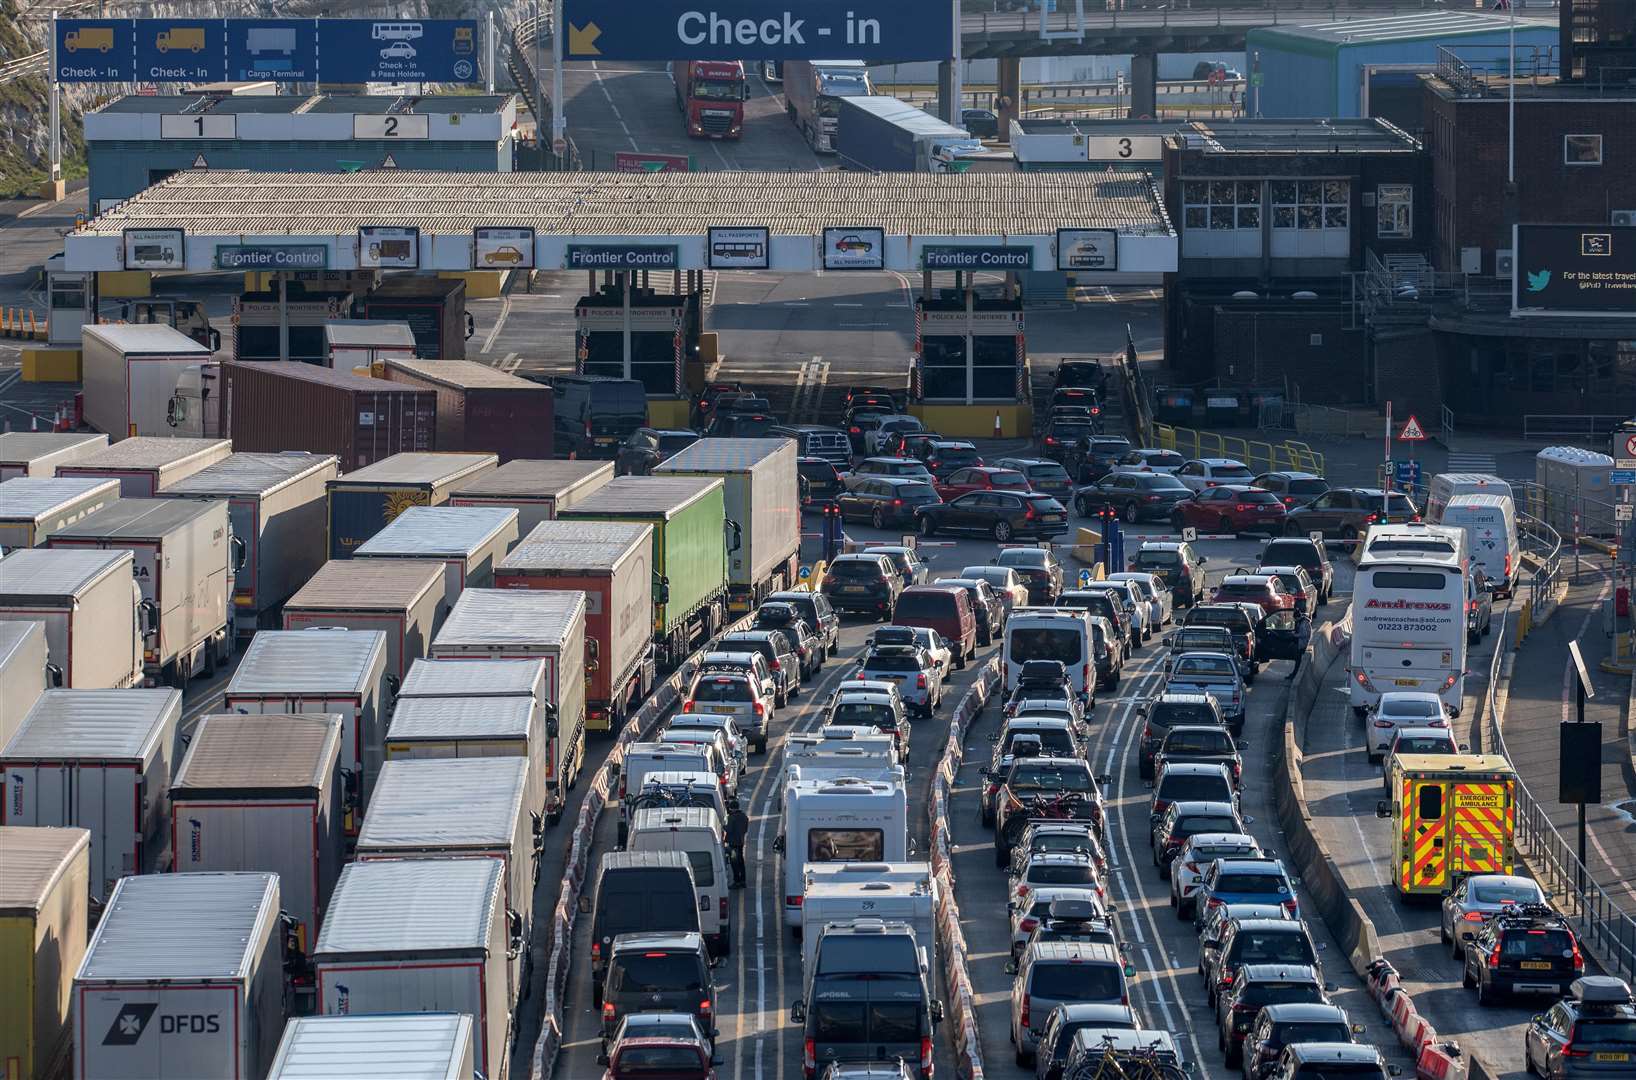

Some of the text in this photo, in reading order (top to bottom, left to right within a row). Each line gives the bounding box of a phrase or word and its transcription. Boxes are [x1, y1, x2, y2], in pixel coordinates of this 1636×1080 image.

[677, 11, 806, 45] Check
[846, 11, 881, 44] in
[60, 67, 97, 77] Check
[107, 67, 119, 77] In
[150, 67, 186, 77] Check
[197, 67, 208, 77] In
[247, 70, 305, 79] Cargo Terminal
[193, 117, 204, 137] 1
[384, 116, 399, 137] 2
[1118, 138, 1132, 158] 3
[221, 251, 323, 263] Frontier Control
[572, 252, 674, 263] Frontier Control
[927, 252, 1029, 264] Frontier Control
[1563, 271, 1577, 280] For
[1578, 271, 1591, 280] the
[1592, 271, 1613, 280] latest
[1186, 530, 1193, 538] K
[1364, 599, 1451, 611] Andrews
[1377, 623, 1438, 632] 01223 873002
[160, 1014, 220, 1034] DFDS
